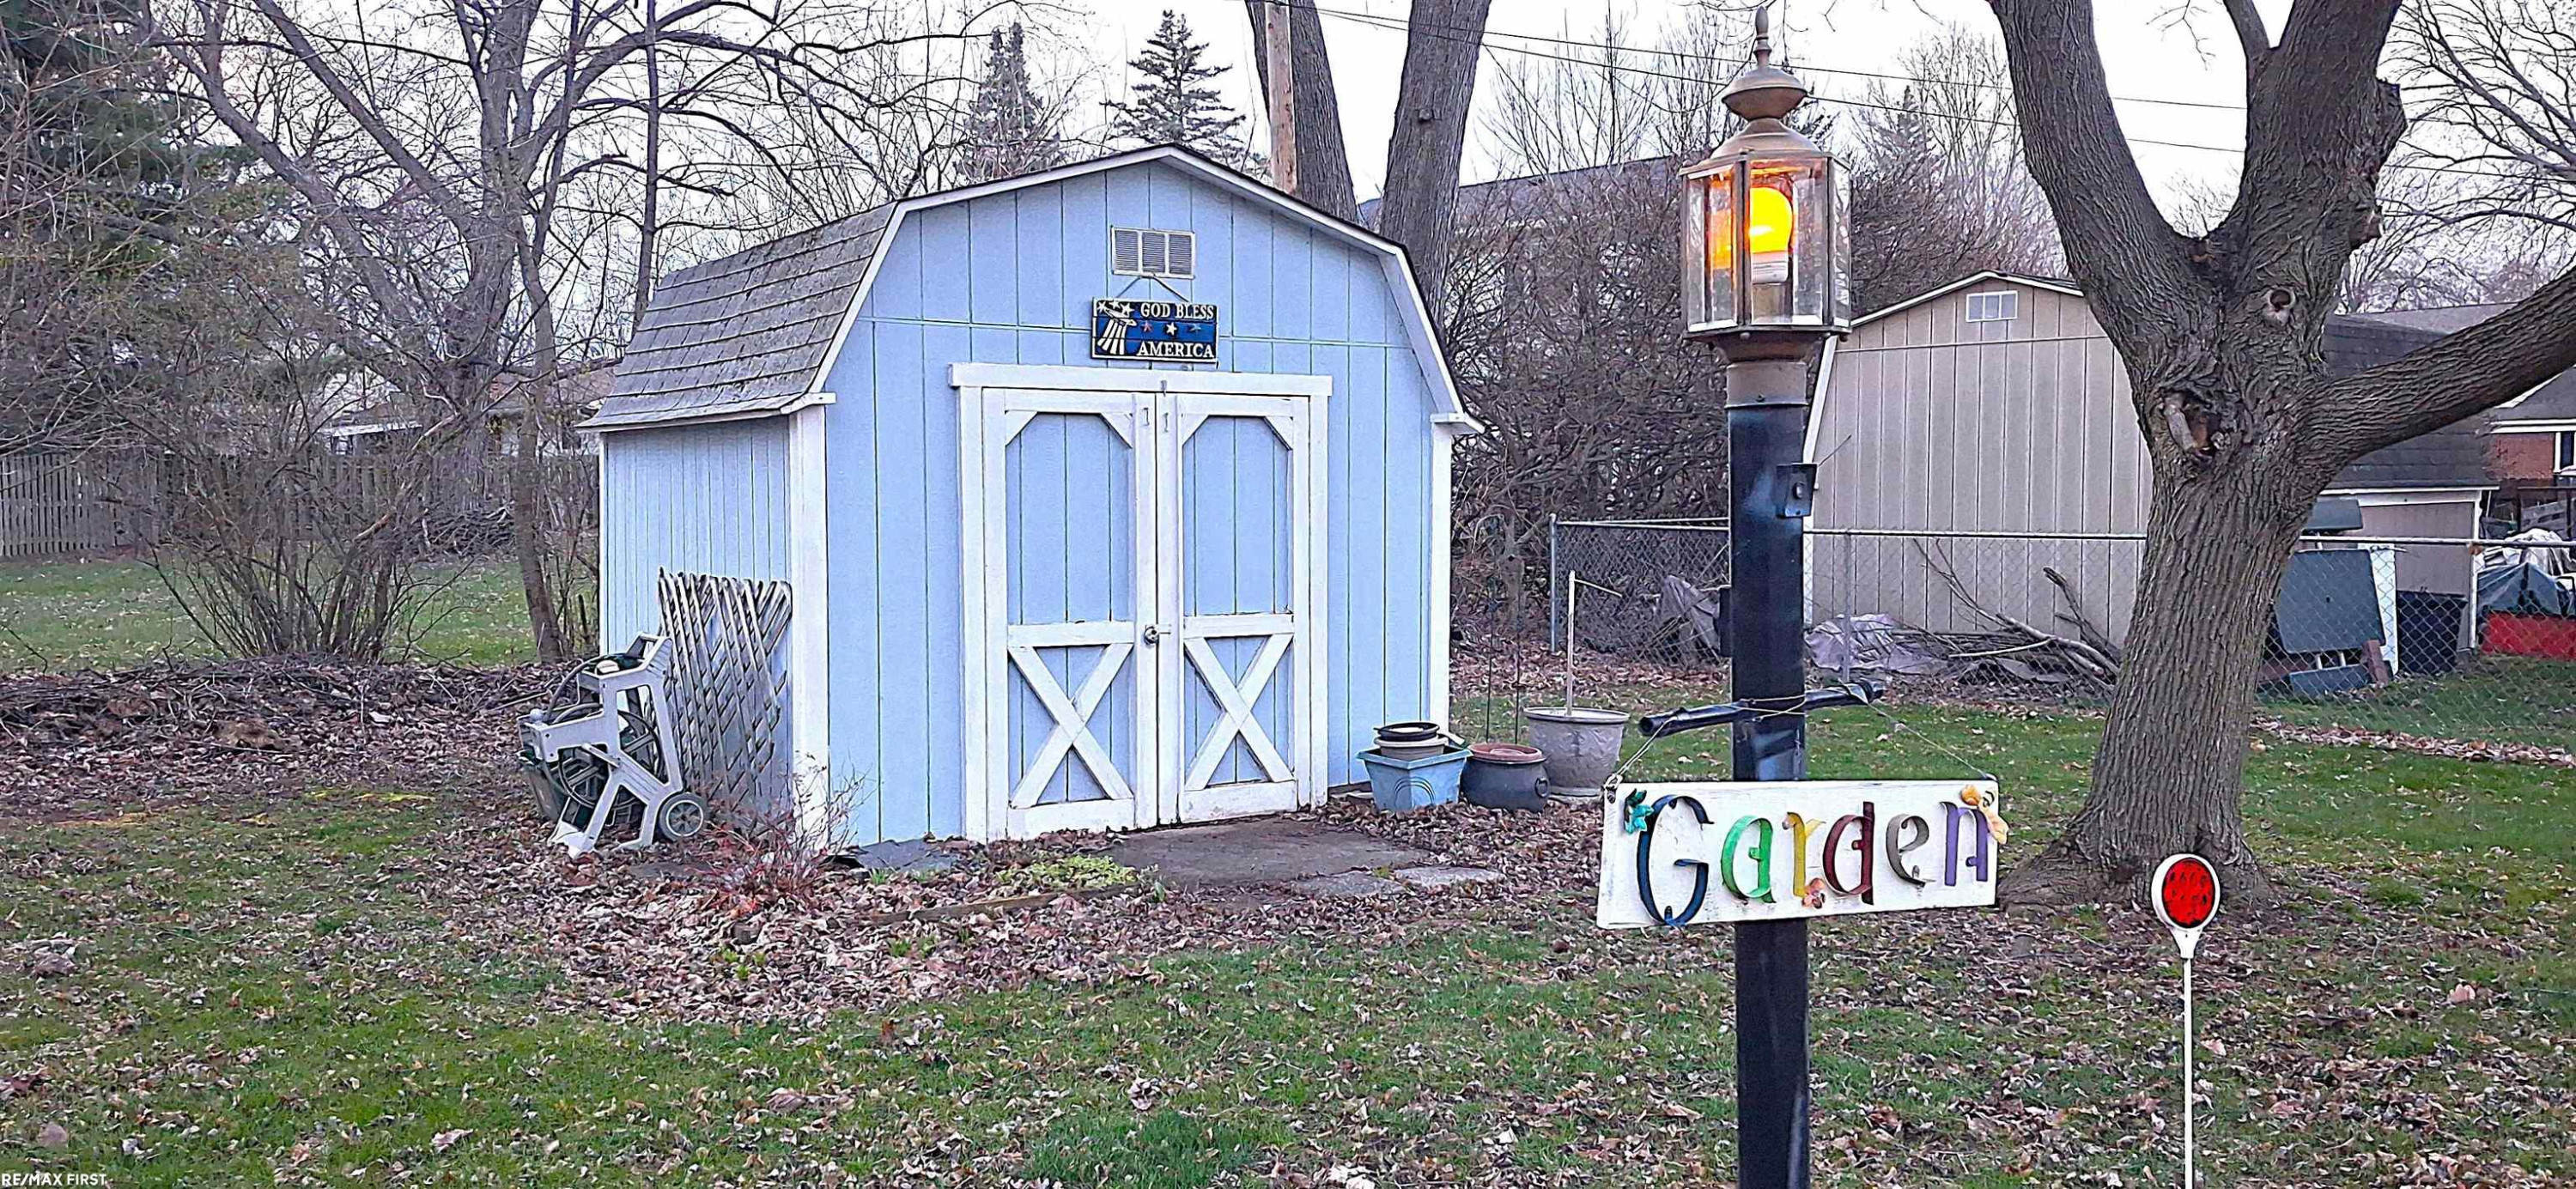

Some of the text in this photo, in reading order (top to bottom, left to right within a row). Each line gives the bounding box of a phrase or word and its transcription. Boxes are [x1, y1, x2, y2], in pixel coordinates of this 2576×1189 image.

[1140, 302, 1214, 320] GOD BLESS
[1136, 341, 1215, 358] AMERICA
[1637, 794, 1989, 926] Garden
